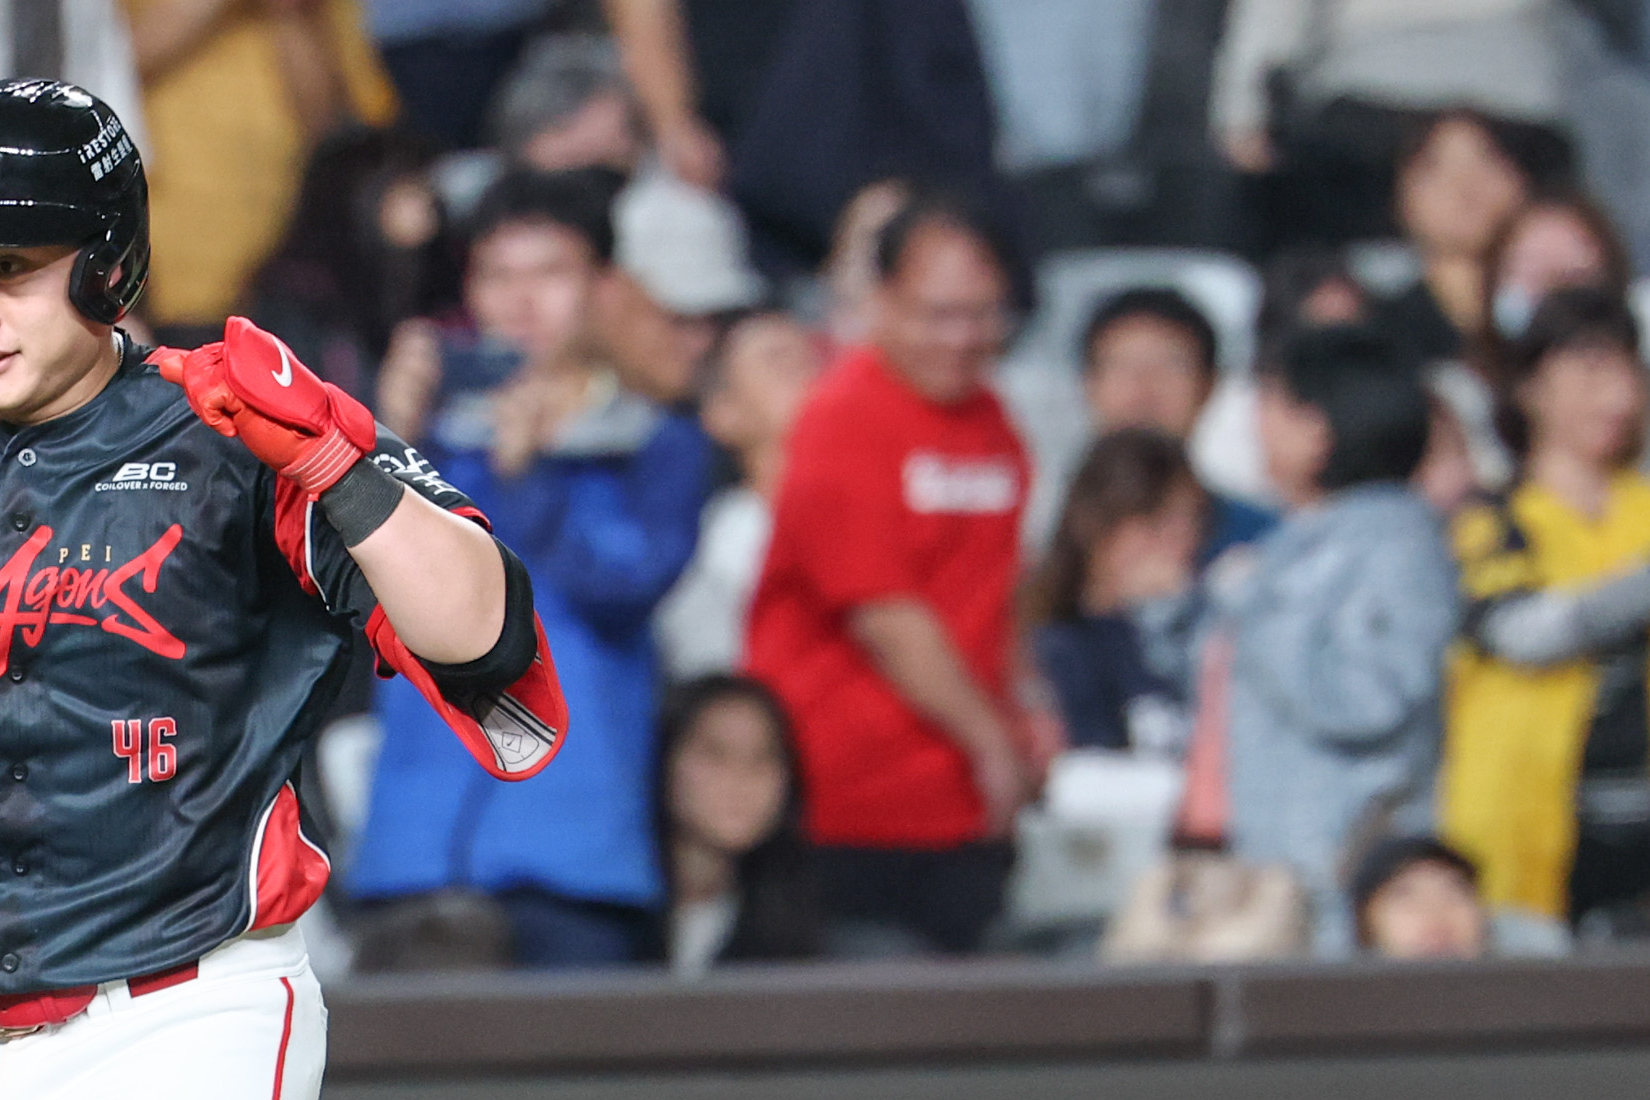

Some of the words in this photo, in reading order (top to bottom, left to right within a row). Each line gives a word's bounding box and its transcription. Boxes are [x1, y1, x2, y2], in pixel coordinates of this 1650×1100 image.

[112, 462, 176, 481] BC
[94, 481, 141, 492] COILOVER
[149, 482, 188, 491] FORGED
[111, 717, 177, 783] 46
